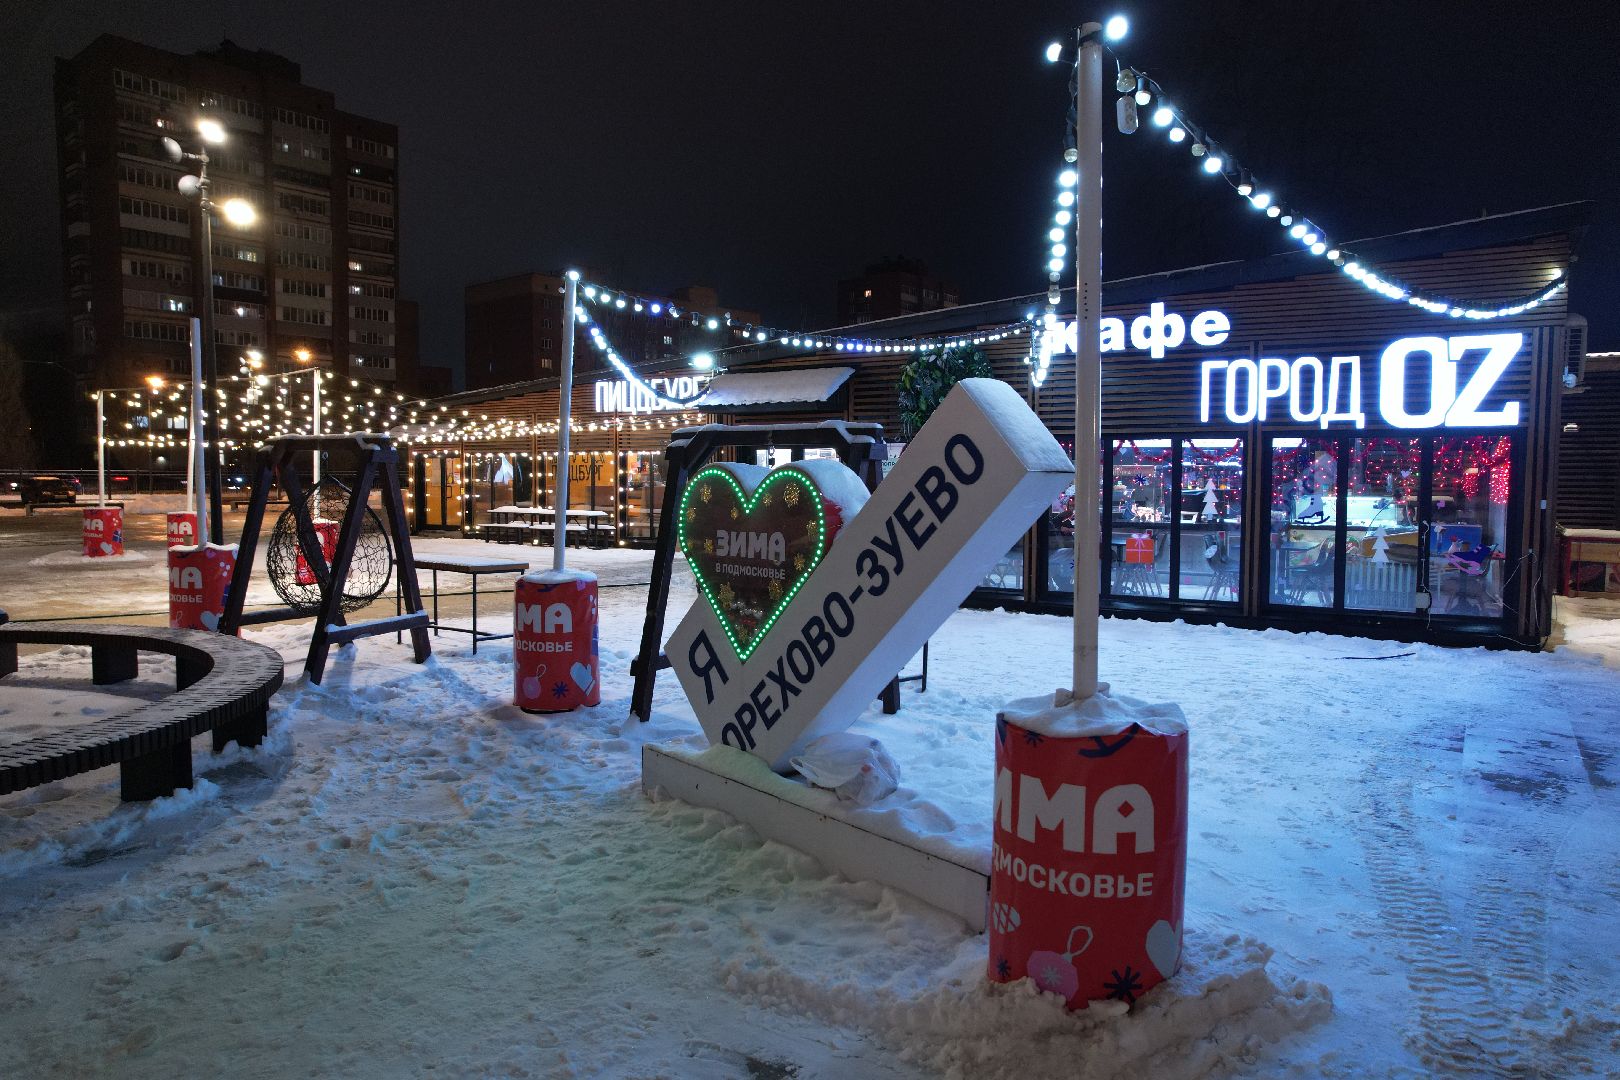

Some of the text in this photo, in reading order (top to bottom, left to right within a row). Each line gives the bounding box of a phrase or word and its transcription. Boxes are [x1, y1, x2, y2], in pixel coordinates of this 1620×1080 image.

[1200, 333, 1523, 430] ГОРОД OZ
[716, 529, 786, 562] ЗИМА
[722, 563, 786, 580] ПОДМОСКОВЬЕ
[721, 433, 985, 752] ОРЕХОВО-ЗУЕВО
[688, 628, 730, 705] Я
